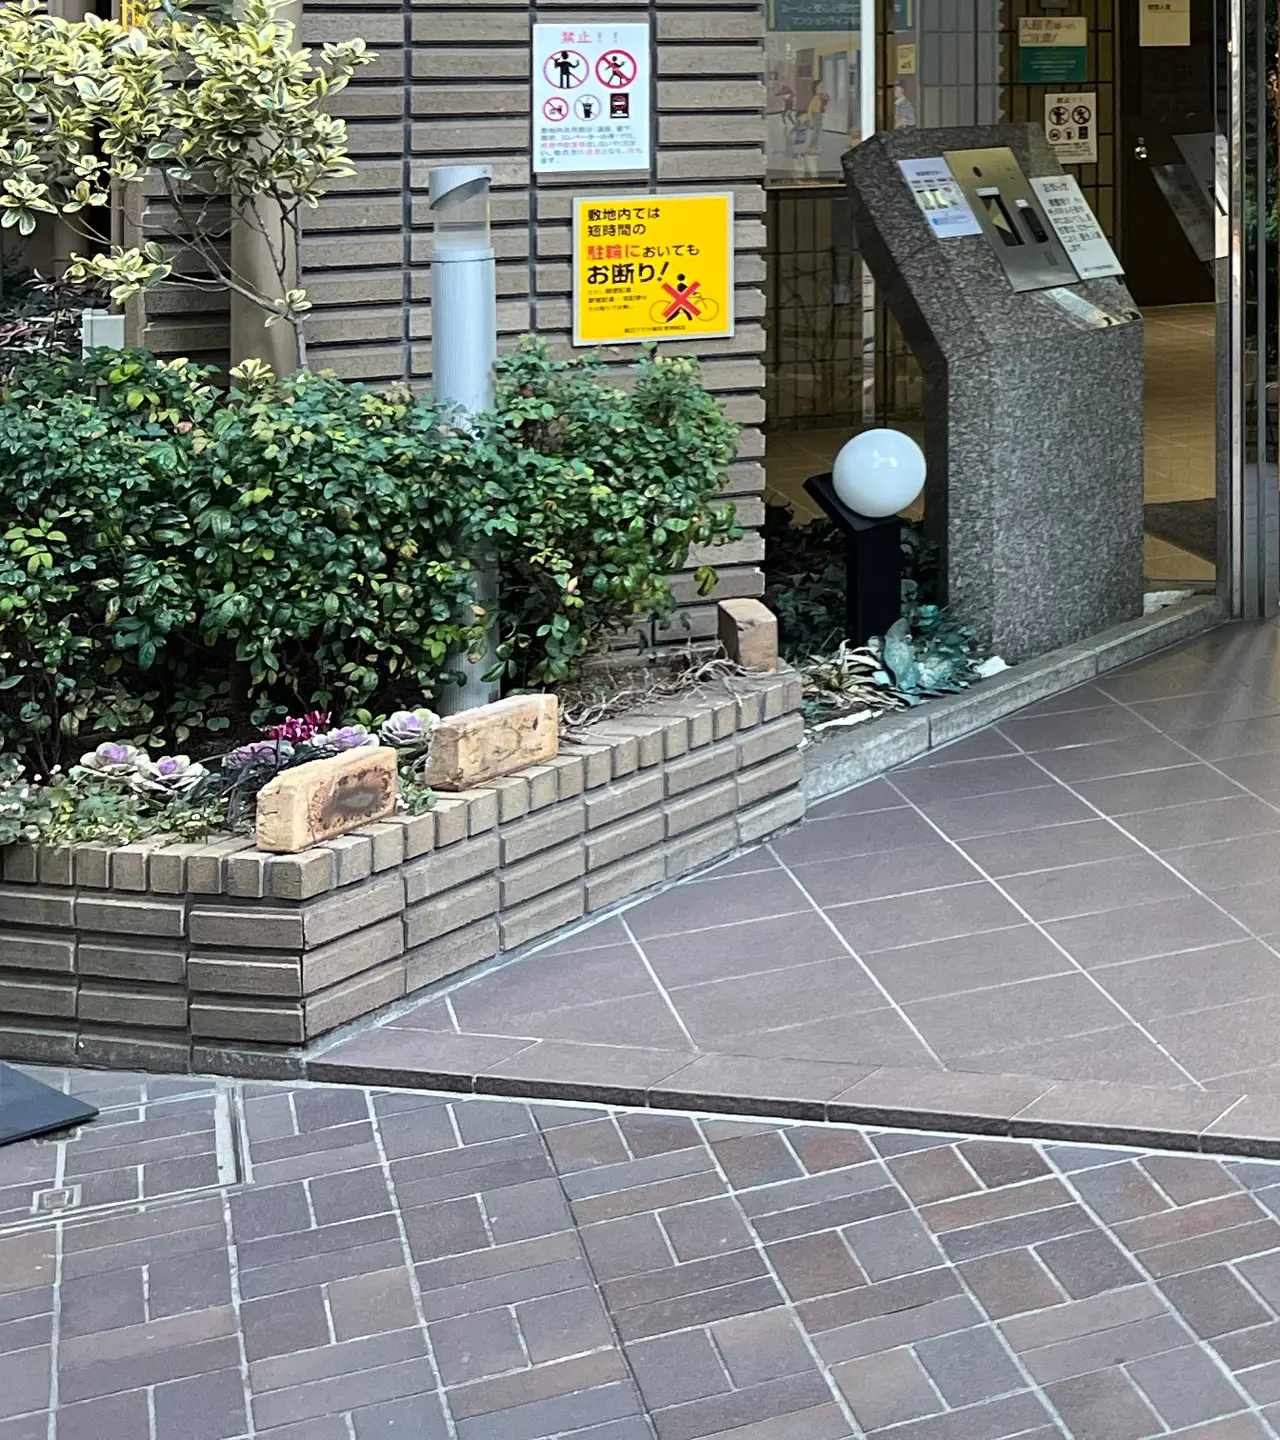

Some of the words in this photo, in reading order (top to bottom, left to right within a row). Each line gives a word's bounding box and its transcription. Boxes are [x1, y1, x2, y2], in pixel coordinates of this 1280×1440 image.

[587, 207, 661, 222] 敷地内では
[587, 224, 646, 238] 短時間の
[587, 244, 699, 261] 駐輪においても
[587, 261, 670, 285] お断り!
